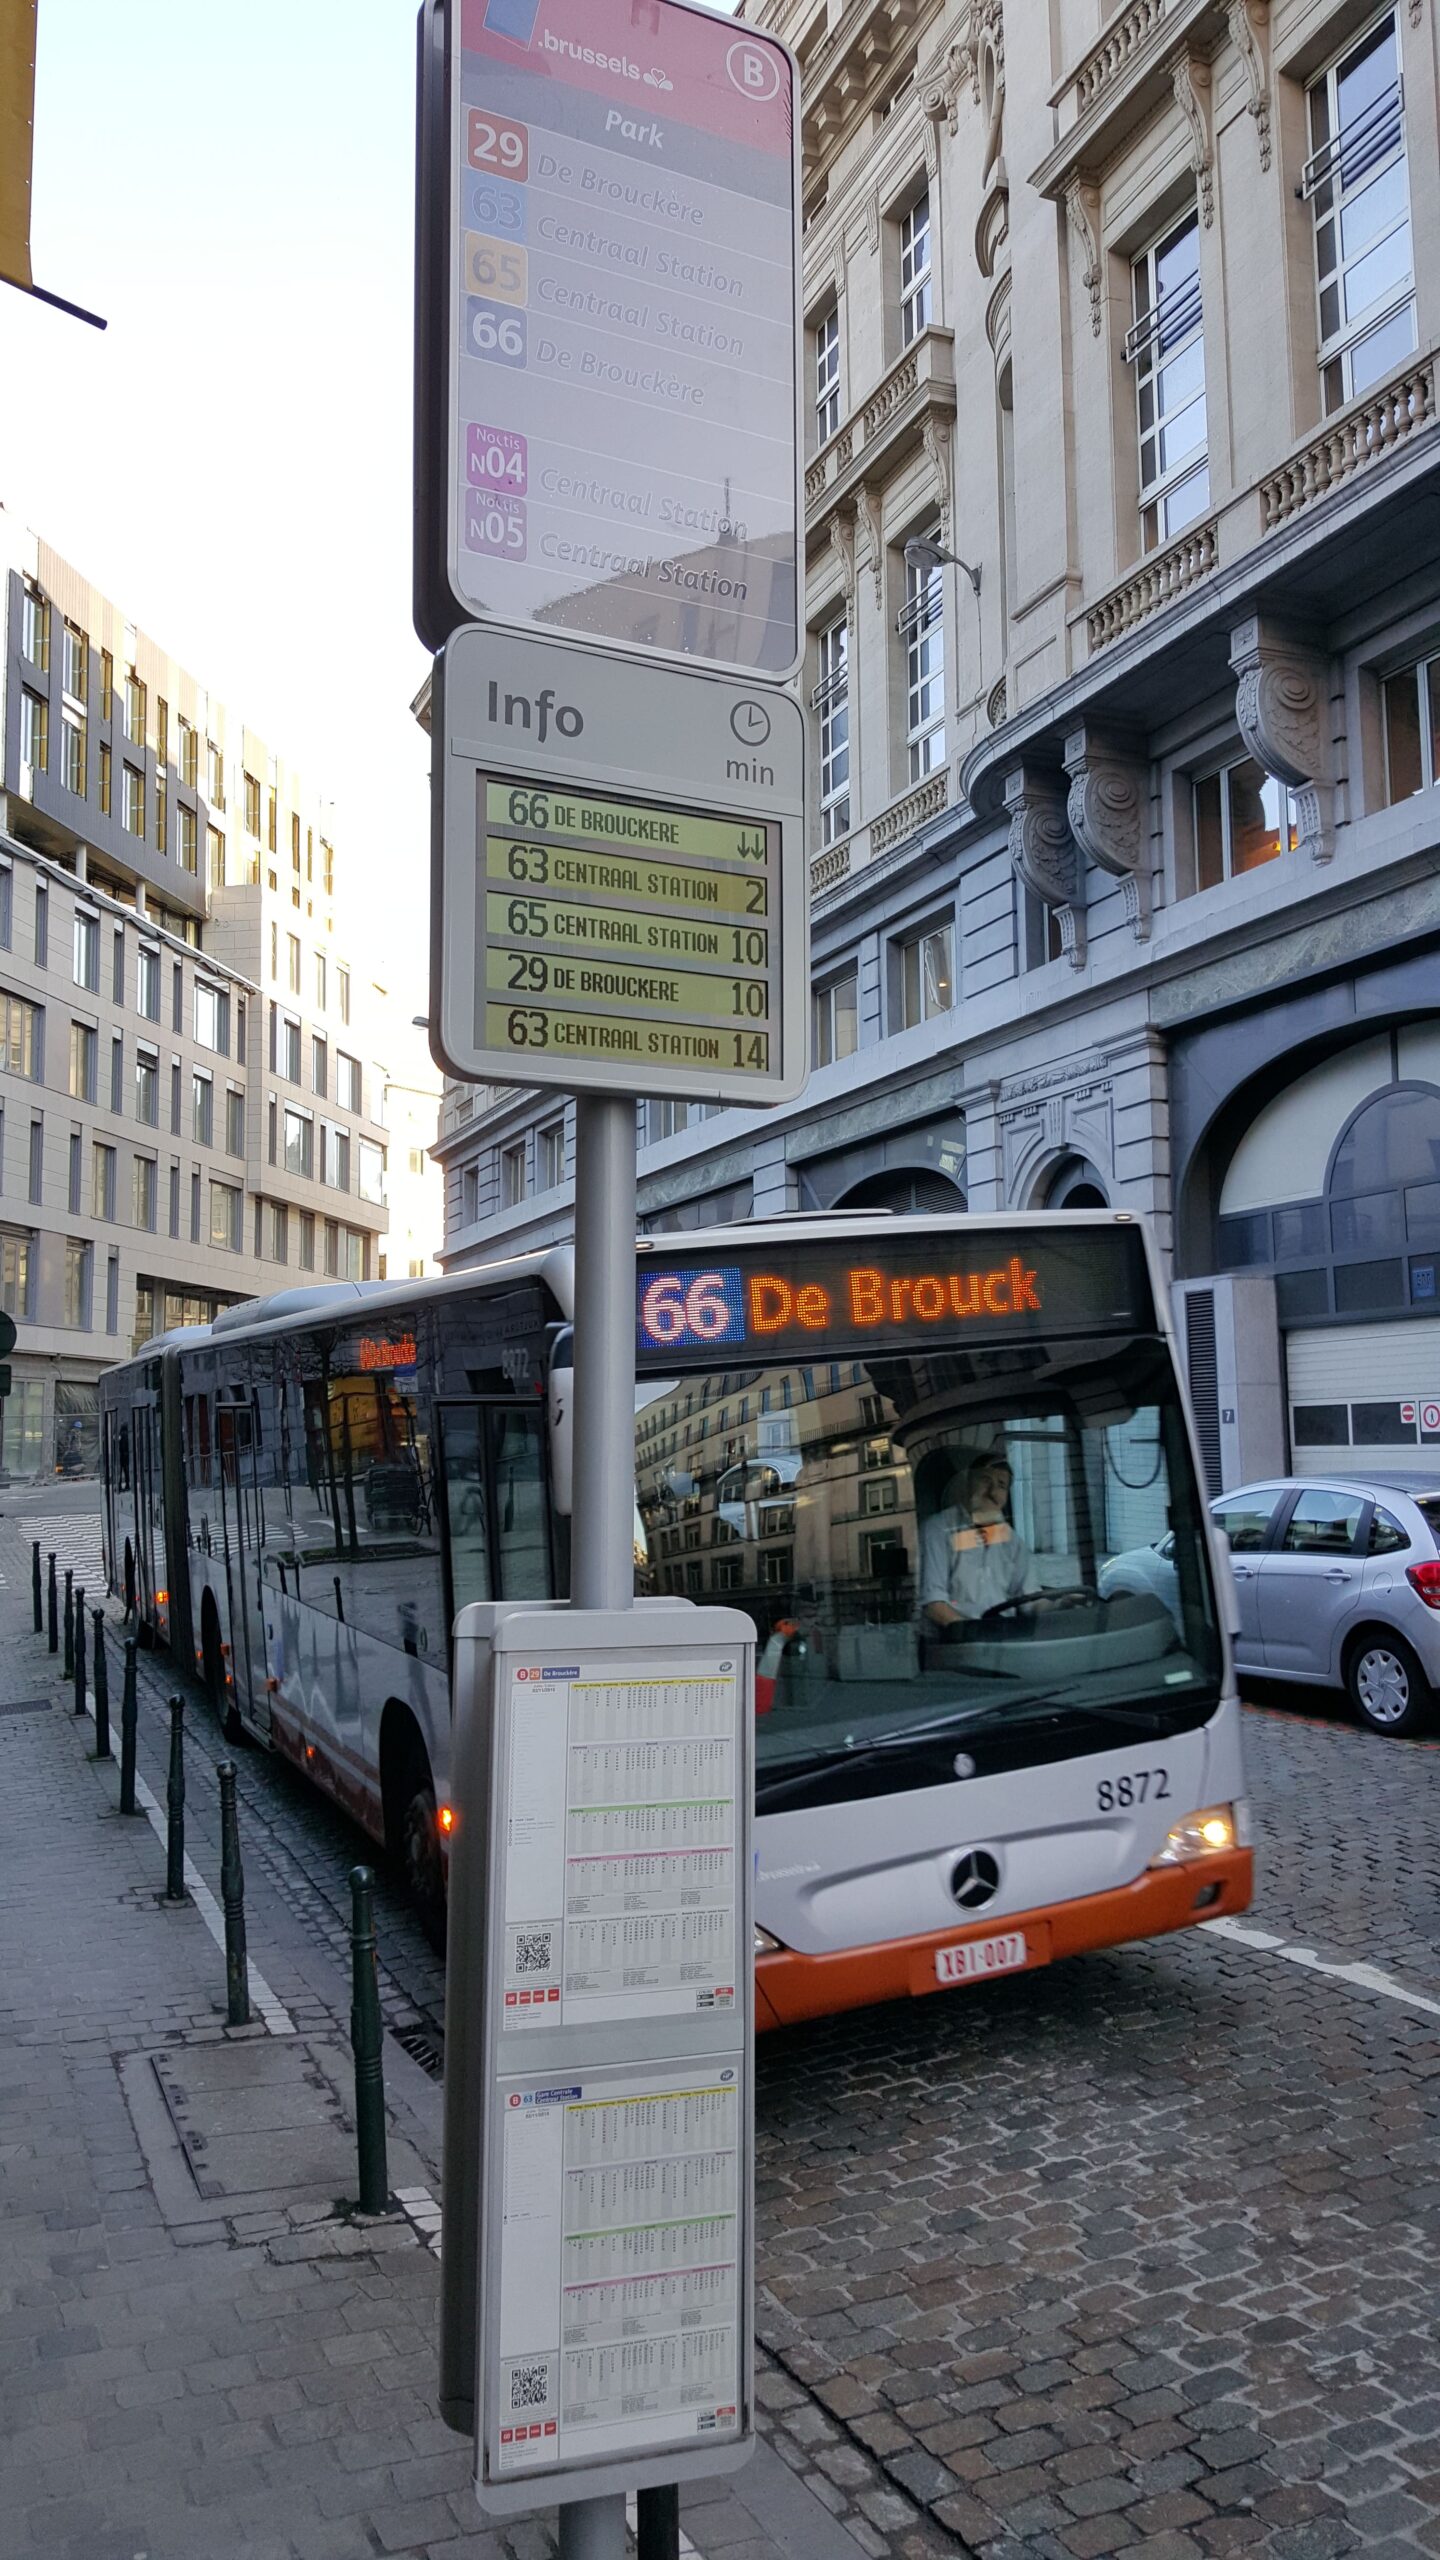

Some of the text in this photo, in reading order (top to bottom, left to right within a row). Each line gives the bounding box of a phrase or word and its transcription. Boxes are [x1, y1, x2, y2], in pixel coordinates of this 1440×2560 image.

[538, 29, 641, 80] .brussels
[743, 53, 765, 88] B
[473, 122, 524, 168] 29
[604, 109, 664, 149] Park
[471, 186, 523, 231] 63
[537, 154, 704, 227] De Brouckère
[471, 248, 522, 292] 65
[537, 215, 744, 297] Centraal Station
[471, 311, 524, 356] 66
[537, 277, 744, 357] Centraal Station
[536, 340, 705, 405] De Brouckère
[475, 427, 520, 450] Noctis
[471, 446, 525, 484] N04
[475, 492, 520, 514] Noctis
[539, 468, 748, 539] Centraal Station
[470, 512, 524, 548] N05
[539, 532, 748, 601] Centraal Station
[488, 681, 584, 743] Info
[726, 758, 775, 786] min
[508, 789, 679, 844] 66 DE BROUCKERE
[508, 844, 764, 915] 63 CENTRAAL STATION 2
[508, 899, 764, 965] 65 CENTRAAL STATION 10
[508, 953, 764, 1017] 29 DE BROUCKERE 10
[508, 1009, 765, 1069] 63 CENTRAAL STATION 14
[643, 1258, 1042, 1342] 66 De Brouck
[1097, 1768, 1171, 1812] 8872
[524, 2095, 532, 2103] 63
